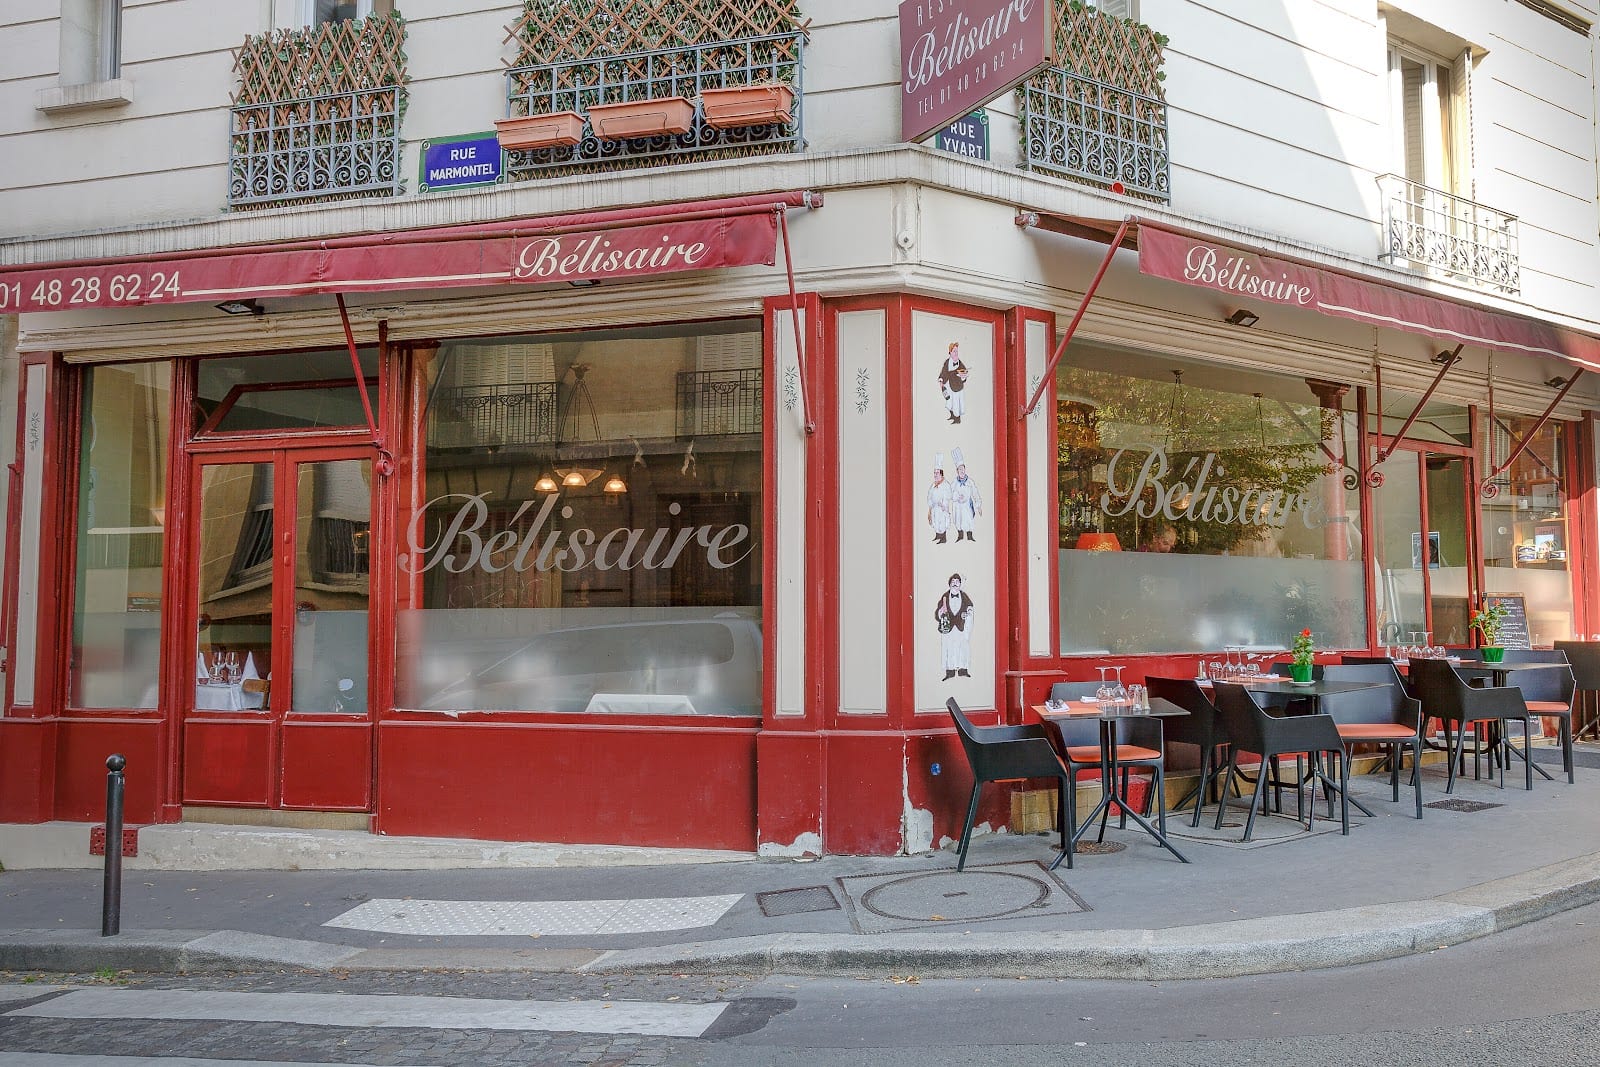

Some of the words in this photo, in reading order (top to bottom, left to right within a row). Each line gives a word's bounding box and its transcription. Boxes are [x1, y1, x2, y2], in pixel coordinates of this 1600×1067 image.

[905, 0, 1036, 94] Bélisaire
[918, 94, 934, 117] TEL
[940, 84, 951, 105] 01
[957, 73, 969, 94] 48
[975, 62, 987, 84] 28
[993, 50, 1005, 72] 62
[1012, 38, 1024, 60] 24
[943, 136, 983, 159] YVART
[950, 121, 976, 139] RUE
[429, 163, 496, 181] MARMONTEL
[450, 147, 477, 161] RUE
[515, 235, 711, 278] Bélisaire
[1184, 245, 1315, 305] Bélisaire
[30, 279, 63, 306] 48
[69, 276, 101, 304] 28
[109, 273, 142, 301] 62
[149, 270, 181, 299] 24
[1100, 442, 1330, 530] Bélisaire
[398, 490, 757, 574] Bélisaire
